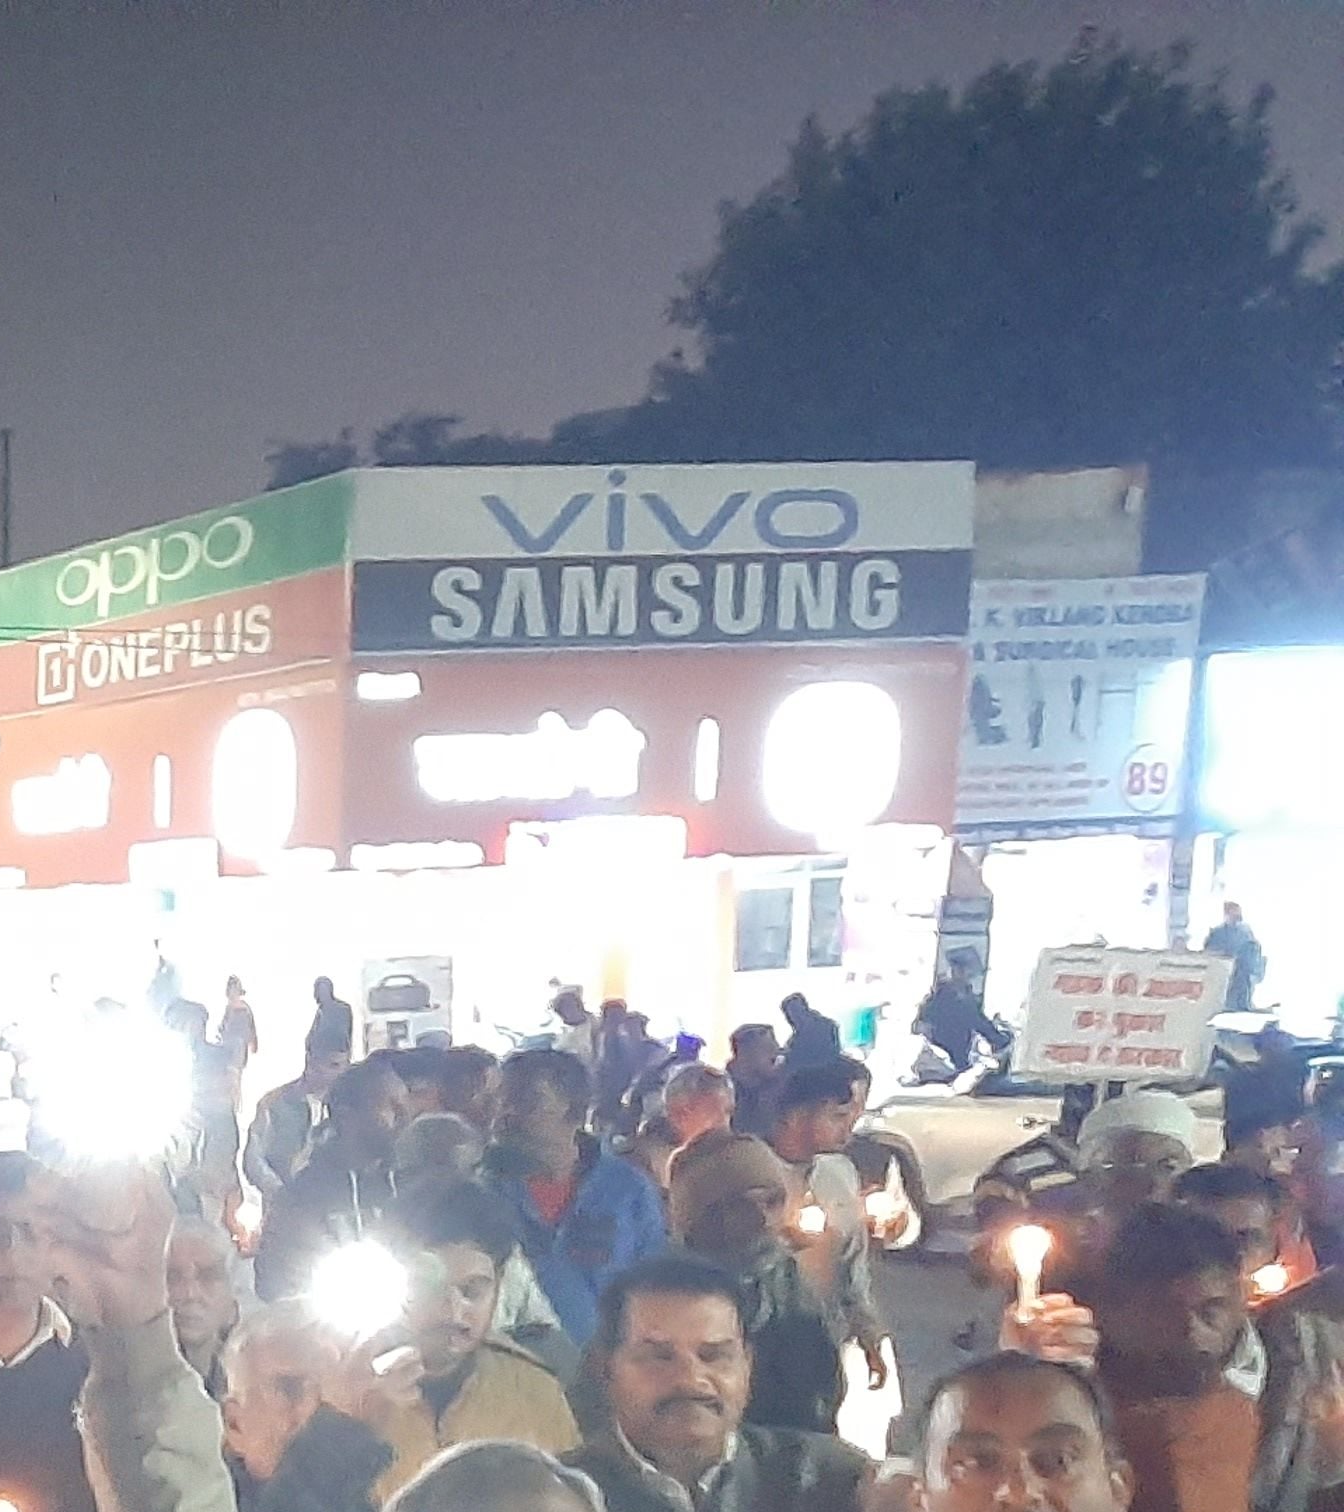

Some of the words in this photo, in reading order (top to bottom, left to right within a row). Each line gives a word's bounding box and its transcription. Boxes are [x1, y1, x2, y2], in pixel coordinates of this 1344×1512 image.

[481, 468, 860, 555] vivo
[56, 515, 254, 618] oppo
[429, 559, 903, 641] SAMSUNG
[81, 604, 273, 688] ONEPLUS
[1127, 761, 1169, 796] 89
